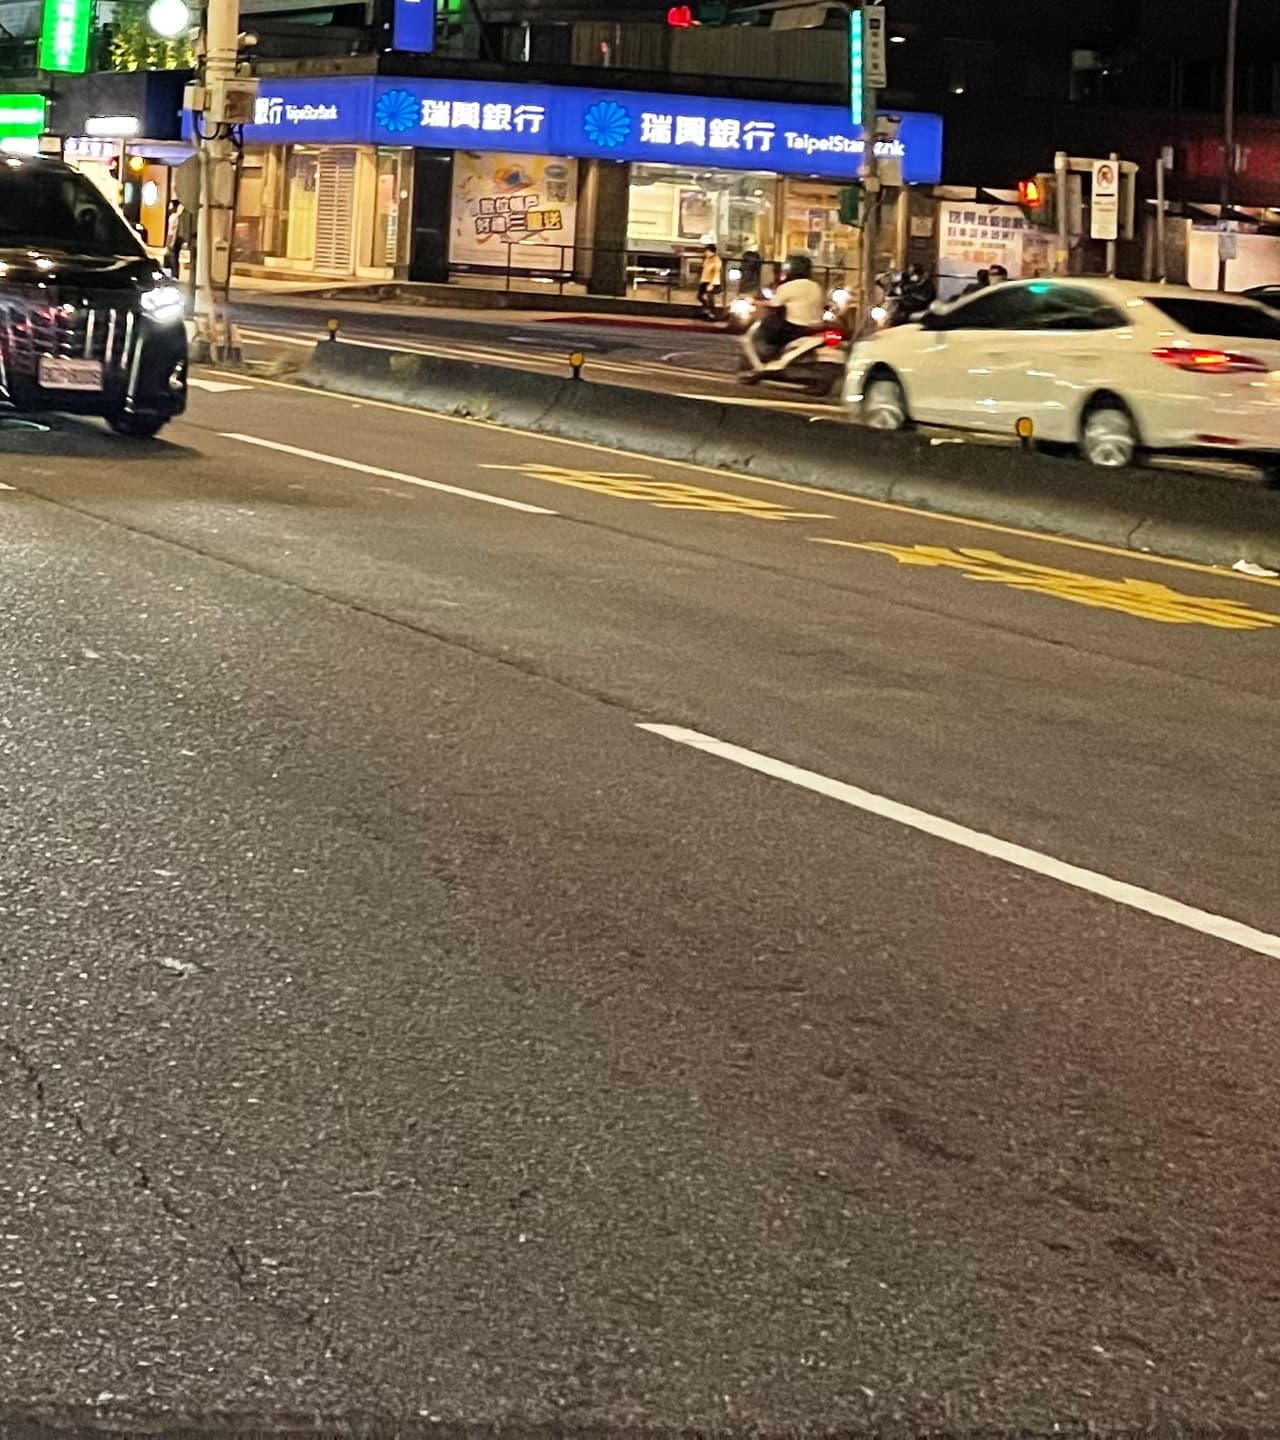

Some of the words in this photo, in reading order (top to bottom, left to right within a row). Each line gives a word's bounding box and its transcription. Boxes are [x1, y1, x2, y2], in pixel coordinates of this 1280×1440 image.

[420, 99, 545, 133] 瑞興銀行
[640, 112, 776, 151] 瑞興銀行
